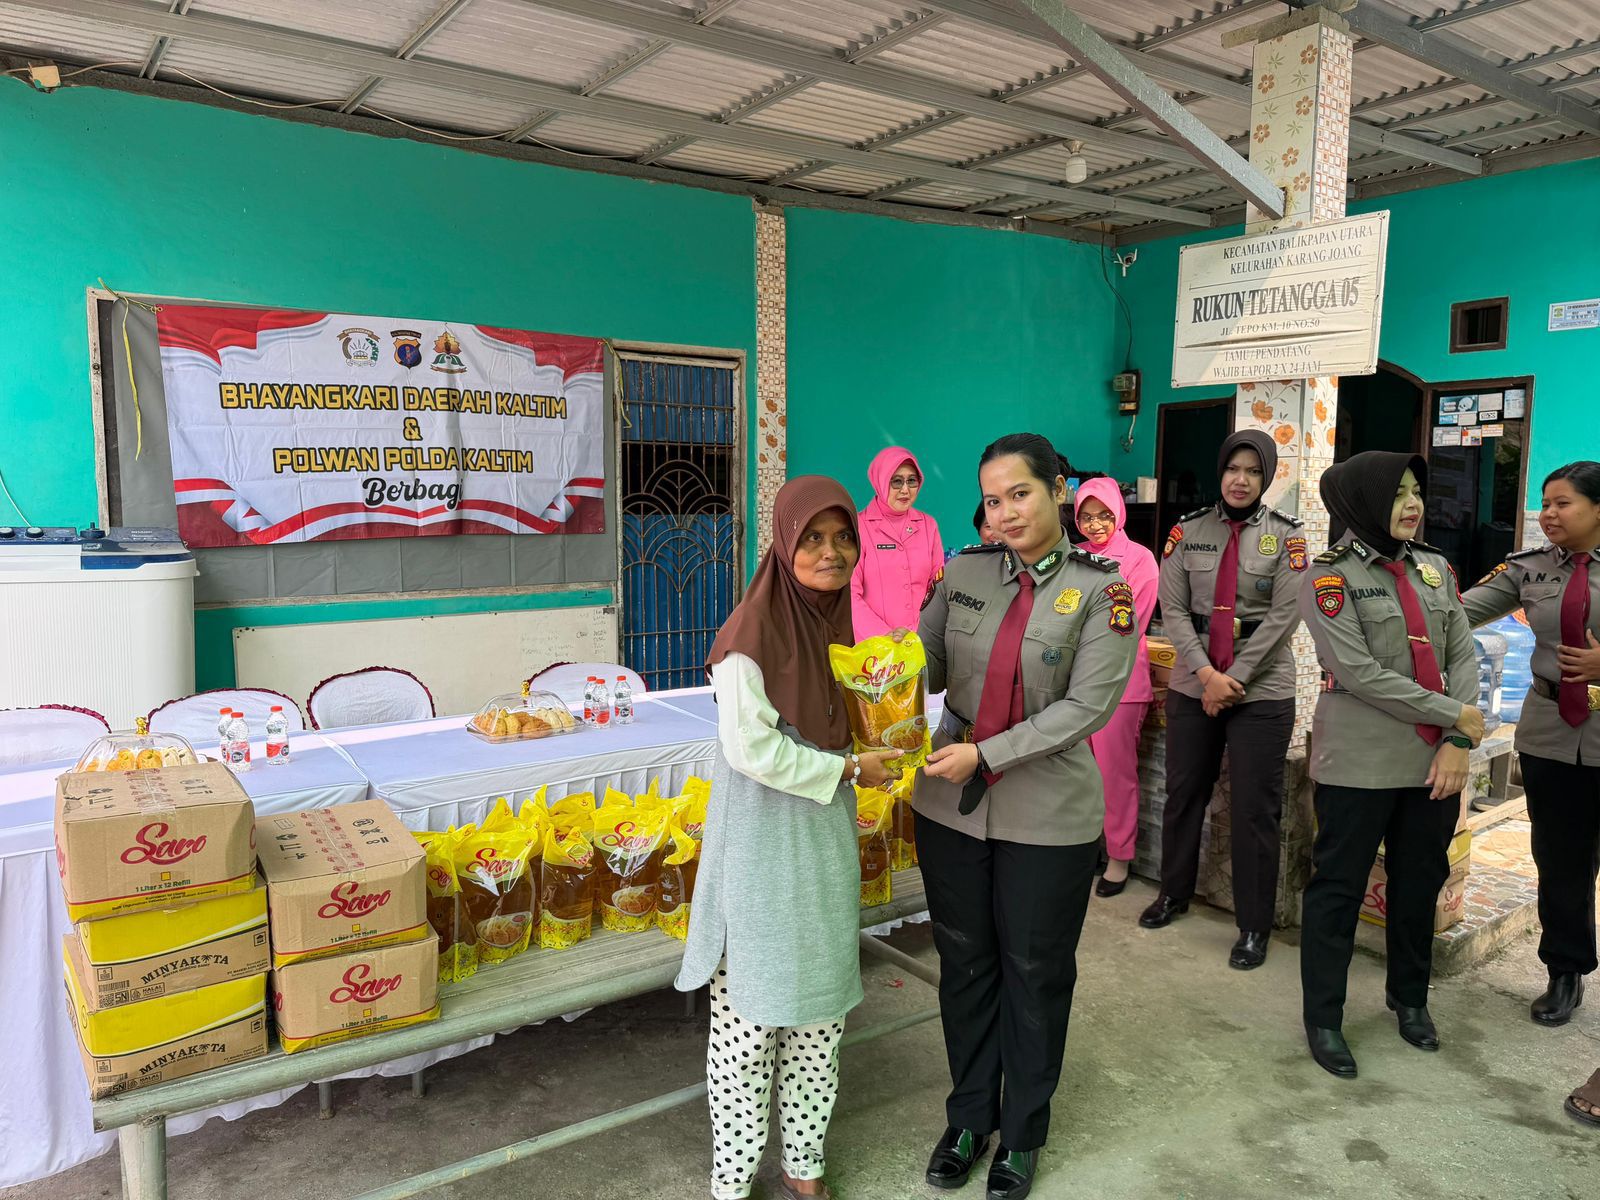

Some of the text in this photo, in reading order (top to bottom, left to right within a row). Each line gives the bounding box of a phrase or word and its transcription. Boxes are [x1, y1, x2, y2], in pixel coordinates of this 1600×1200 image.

[1223, 225, 1373, 259] KECAMATAN BALIKPAPAN UTARA
[1230, 244, 1362, 275] KELURAHAN KARANG JOANG
[1192, 277, 1361, 323] RUKUN TETANGGA 05
[1224, 348, 1248, 361] TAMU
[1255, 344, 1312, 360] PENDATANG
[1213, 366, 1239, 378] WAJIB
[1241, 364, 1272, 376] LAPOR
[1274, 363, 1279, 375] 2
[1290, 362, 1299, 373] 24
[1300, 360, 1321, 373] JAM
[219, 382, 567, 419] BHAYANGKARI DAERAH KALTIM
[403, 416, 423, 441] &
[272, 446, 534, 473] POLWAN POLDA KALTIM
[362, 477, 464, 510] Berbagi
[1184, 543, 1217, 553] ANNISA
[852, 655, 905, 687] Saro
[120, 822, 207, 865] Saro
[140, 884, 157, 892] Liter
[172, 879, 191, 887] Refill
[317, 881, 391, 918] Saro
[329, 963, 402, 1003] Saro
